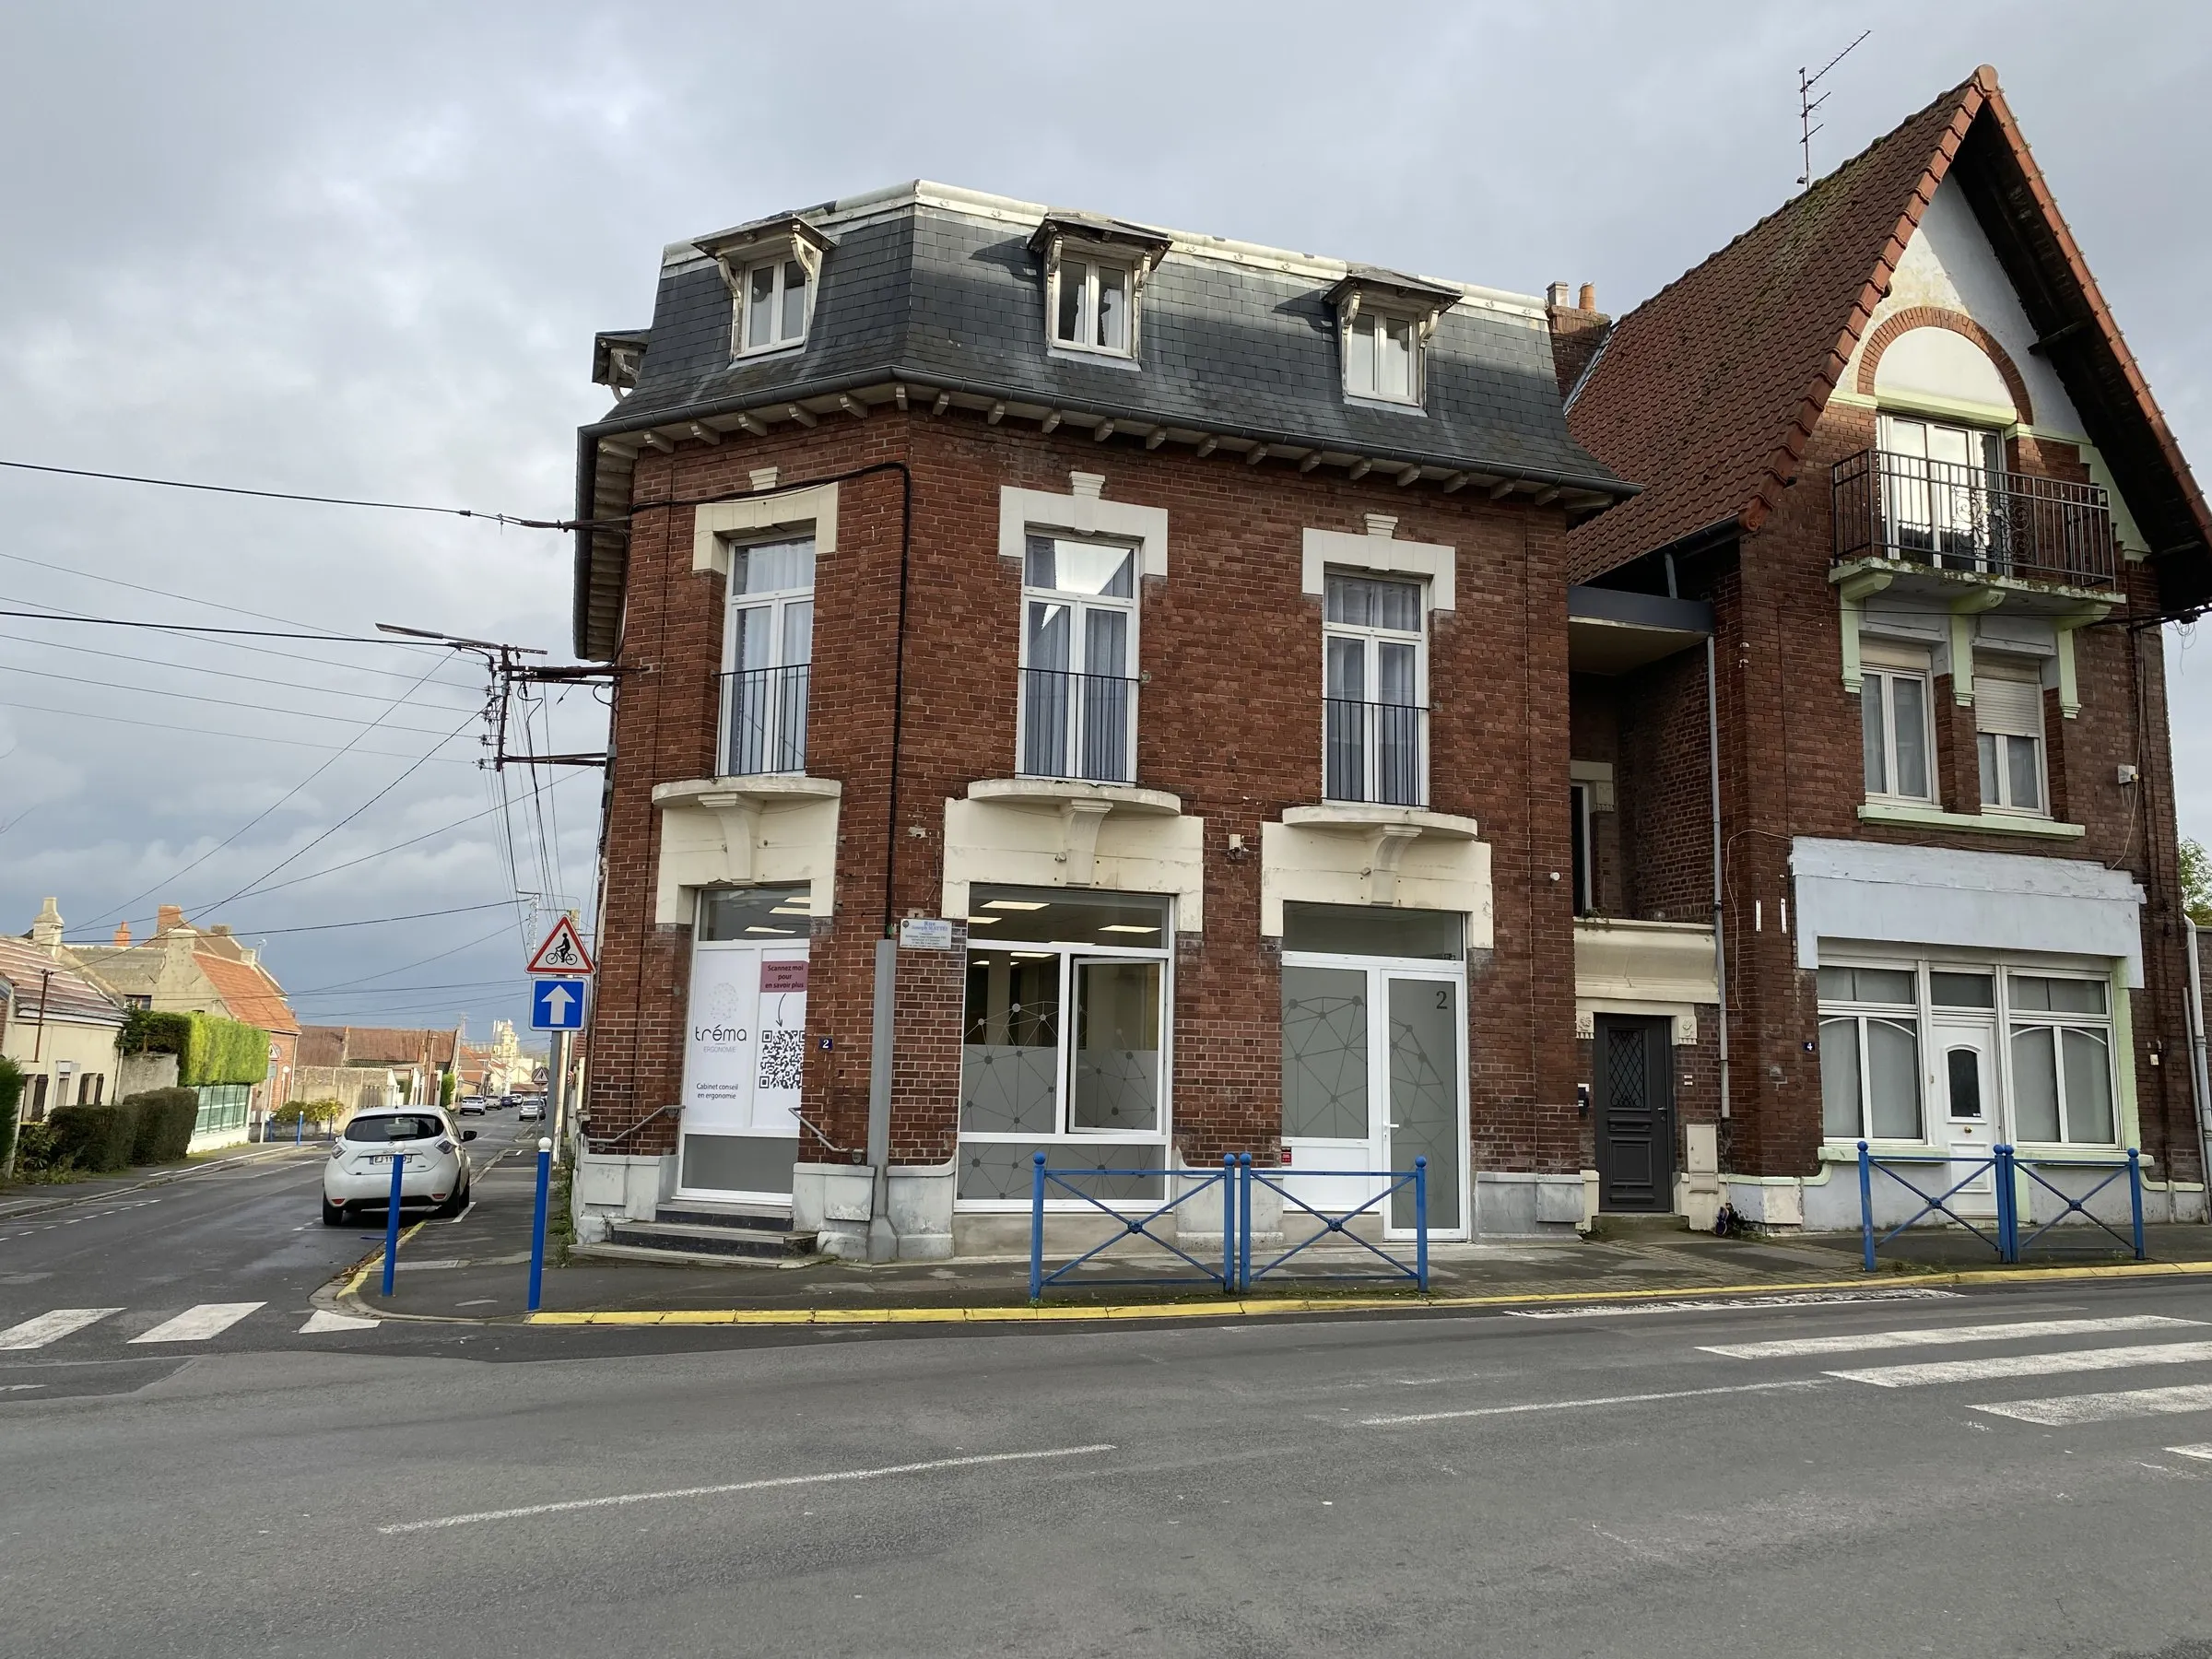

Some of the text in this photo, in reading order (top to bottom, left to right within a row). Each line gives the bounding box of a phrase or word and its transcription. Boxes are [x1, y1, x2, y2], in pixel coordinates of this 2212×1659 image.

[792, 981, 804, 990] plus
[1436, 990, 1447, 1009] 2
[695, 1023, 747, 1041] tréma
[822, 1039, 830, 1049] 2
[696, 1082, 718, 1090] Cabinet
